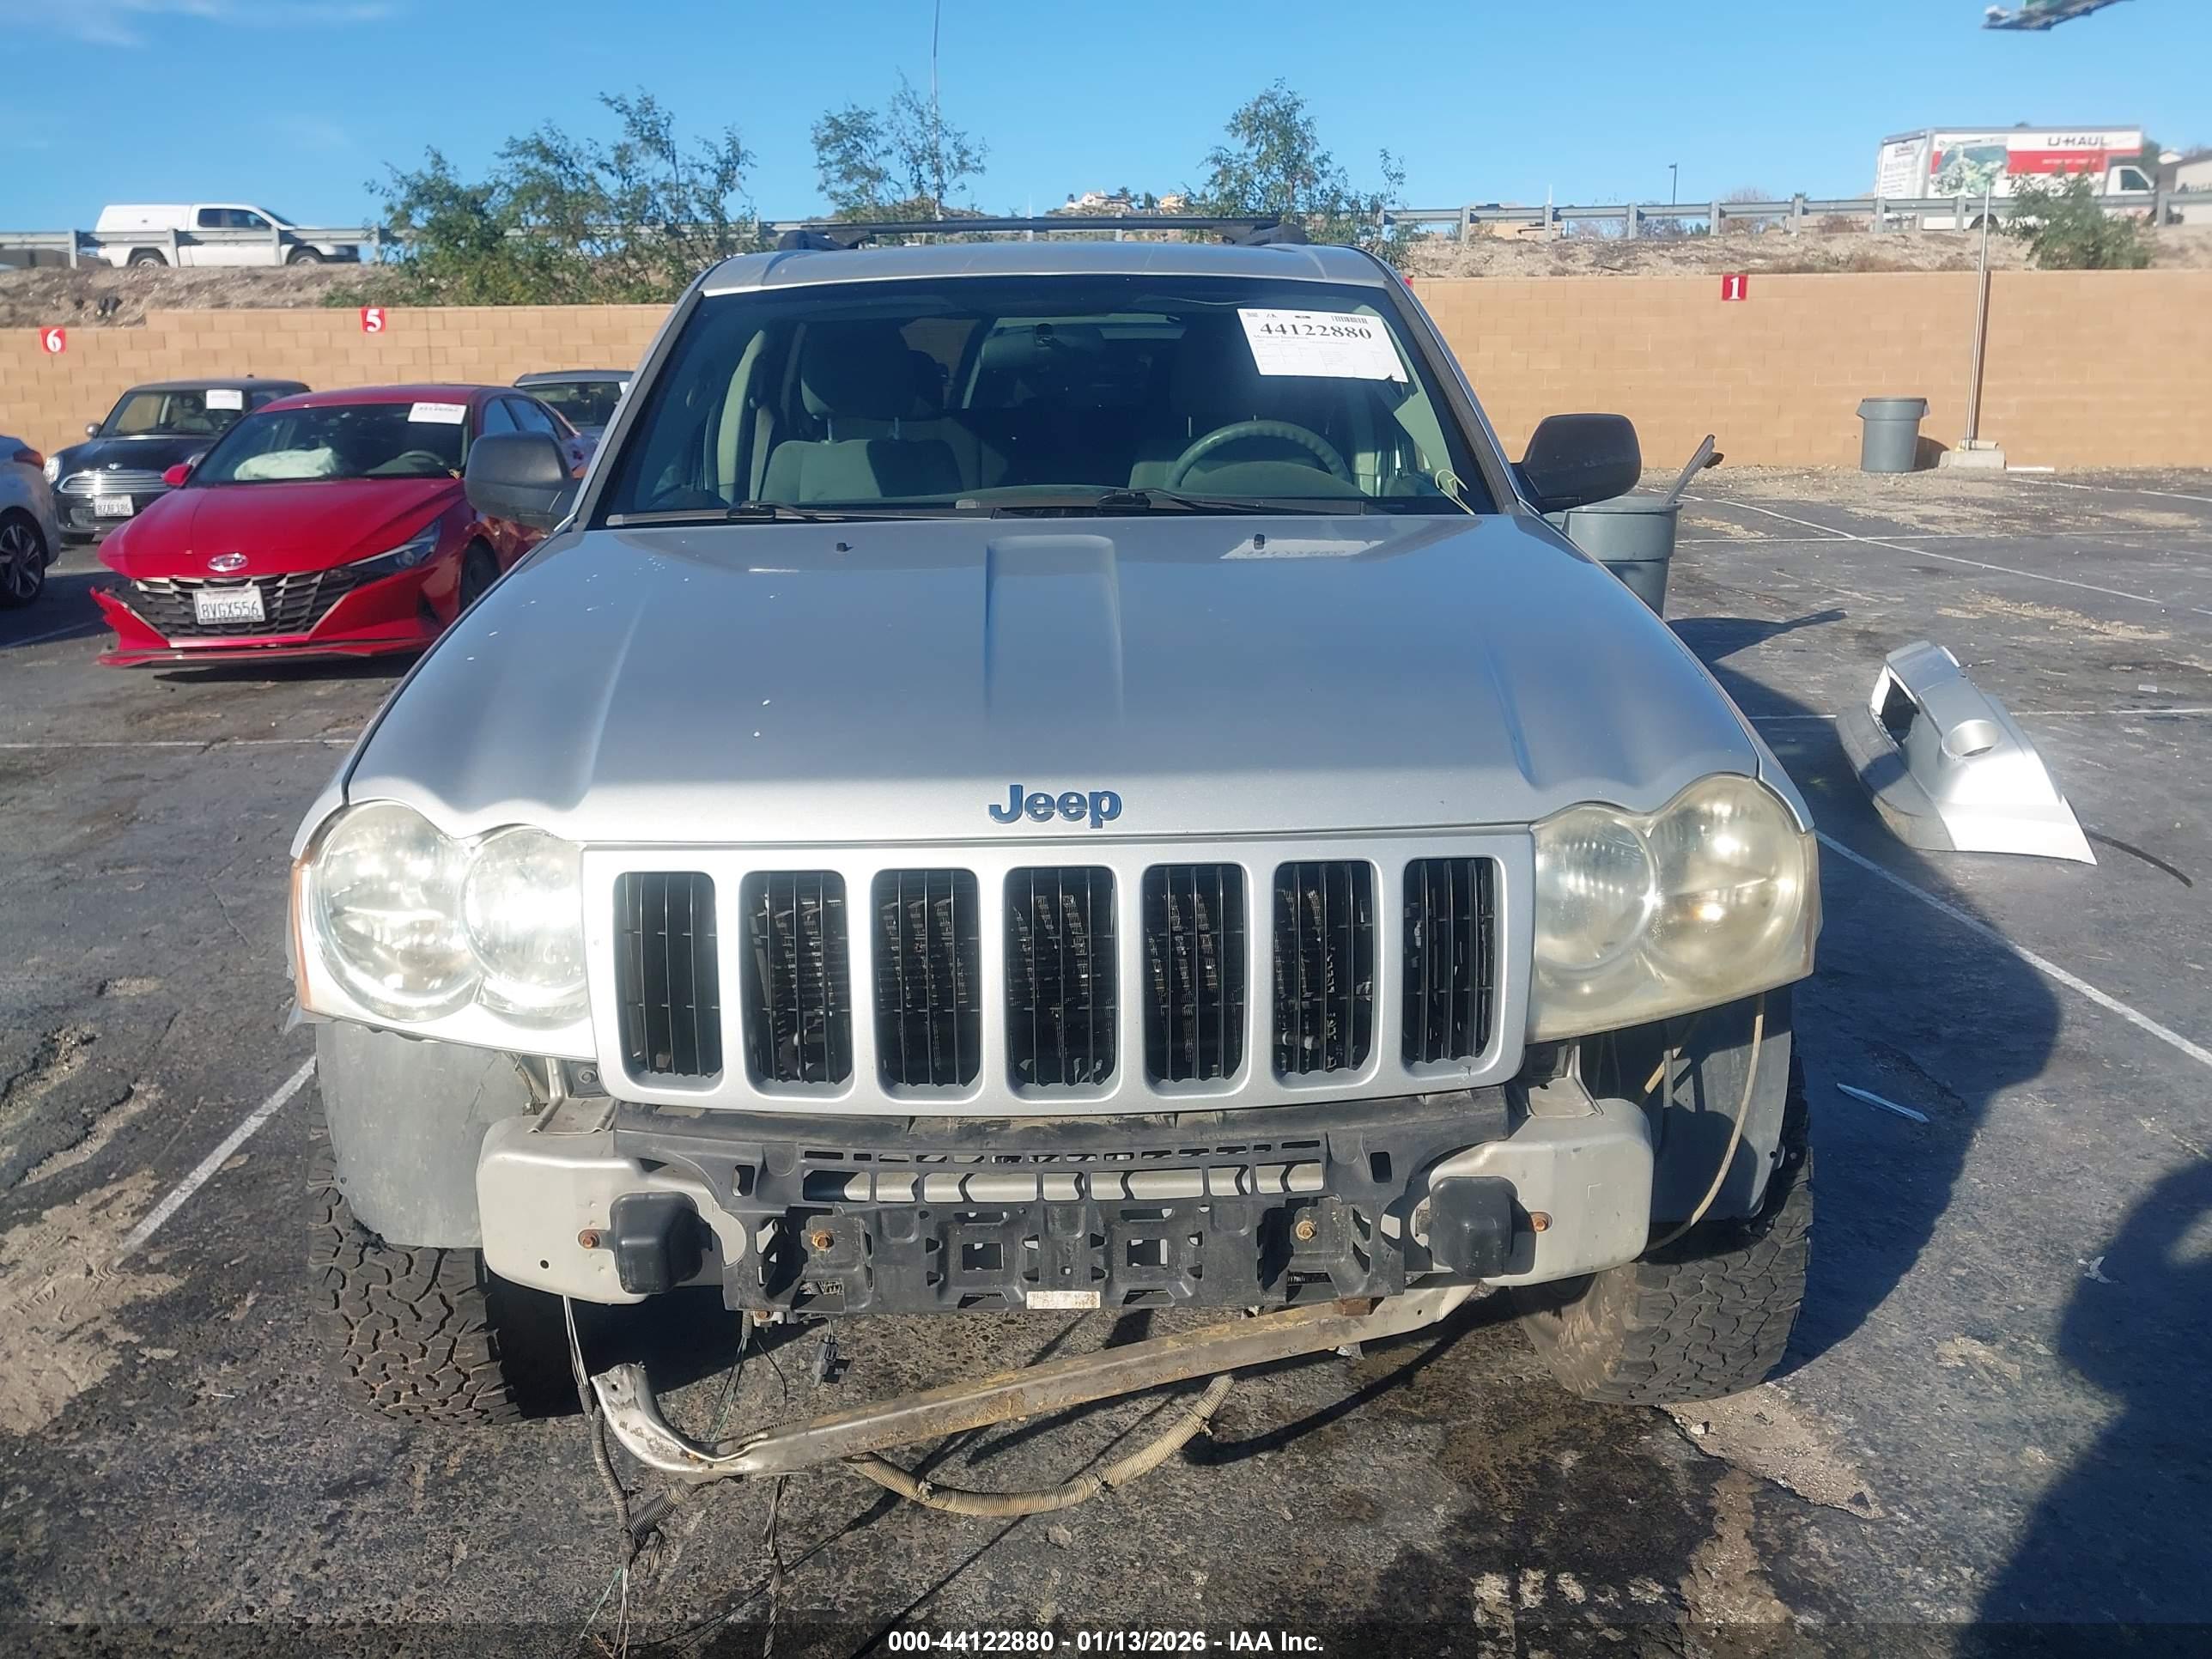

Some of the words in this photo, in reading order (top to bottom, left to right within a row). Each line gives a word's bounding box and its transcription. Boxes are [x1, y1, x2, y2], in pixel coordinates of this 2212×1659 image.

[1729, 276, 1740, 300] 1
[366, 308, 382, 332] 5
[1260, 322, 1372, 340] 44122880
[46, 328, 62, 352] 6
[200, 600, 259, 618] 8VGX556
[988, 784, 1122, 829] Jeep
